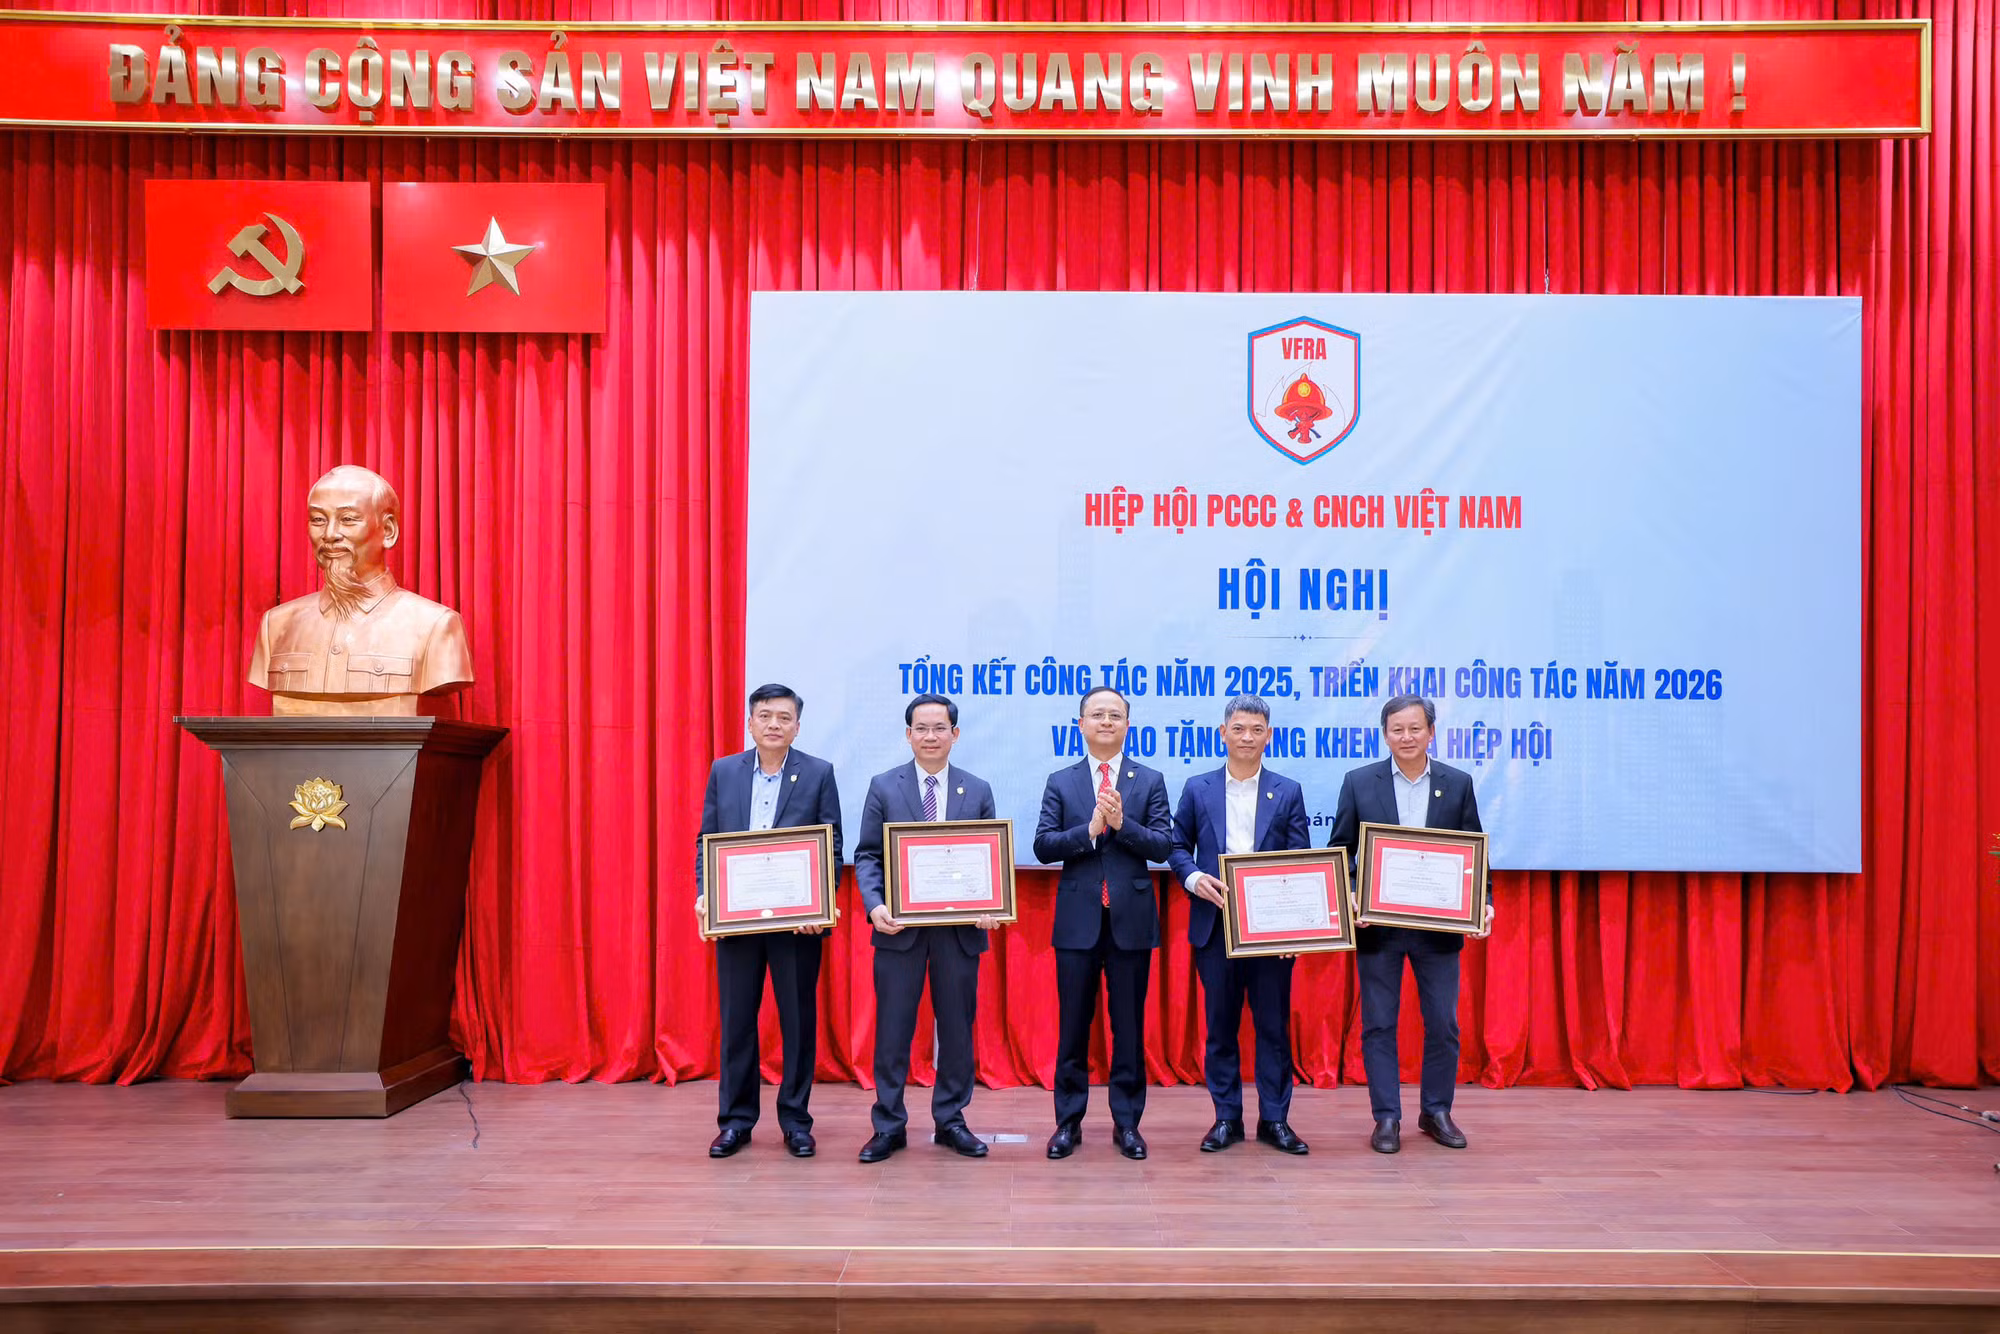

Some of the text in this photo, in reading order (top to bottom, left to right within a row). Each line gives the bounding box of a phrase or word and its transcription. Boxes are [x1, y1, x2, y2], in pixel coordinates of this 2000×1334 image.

[108, 25, 1747, 128] ĐẢNG CỘNG SẢN VIỆT NAM QUANG VINH MUÔN NĂM !
[1281, 337, 1327, 360] VFRA
[1085, 486, 1522, 536] HIỆP HỘI PCCC & CNCH VIỆT NAM
[1218, 558, 1389, 621] HỘI NGHỊ
[899, 655, 1723, 701] TỔNG KẾT CÔNG TÁC NĂM 2025, TRIỂN KHAI CÔNG TÁC NĂM 2026
[1124, 726, 1157, 758] AO
[1315, 727, 1380, 758] KHEN
[1447, 720, 1502, 767] HIỆP
[1511, 720, 1553, 767] HỘI
